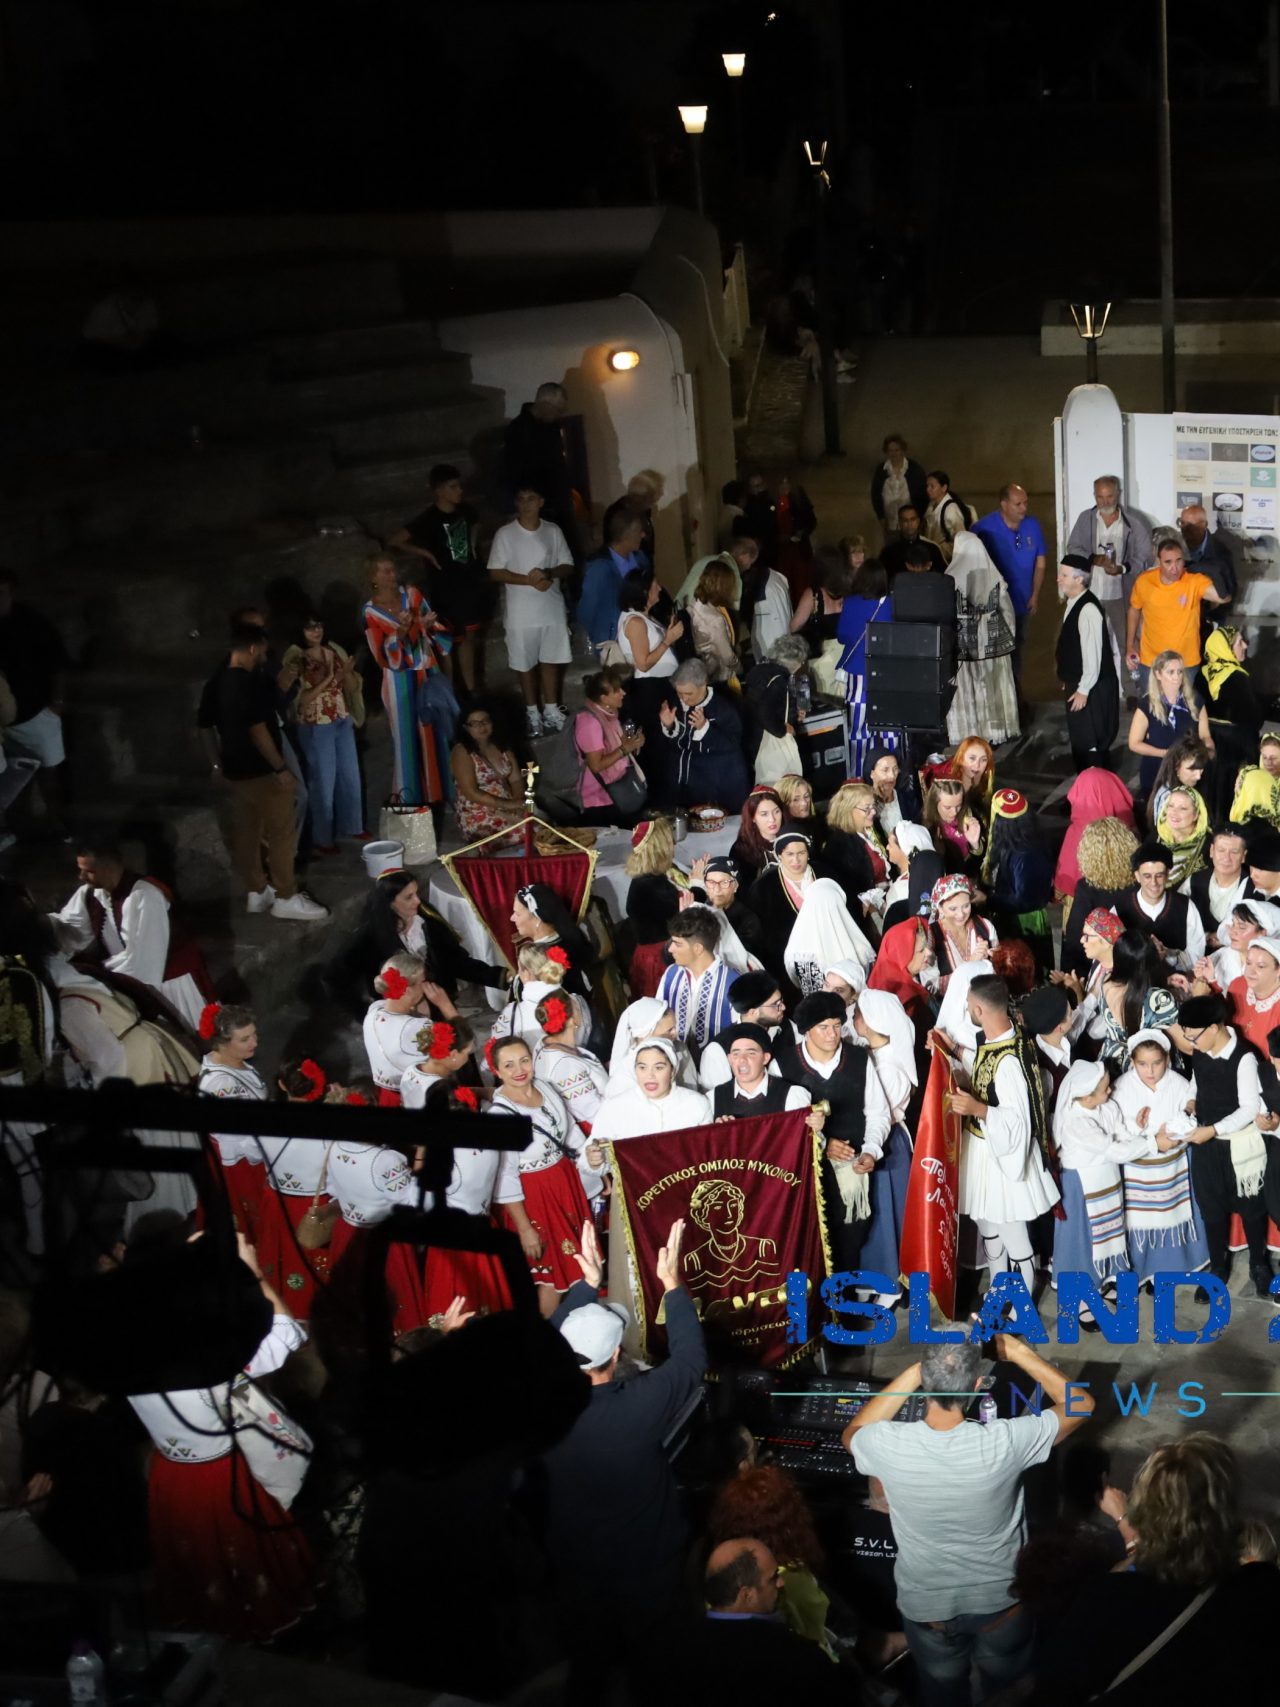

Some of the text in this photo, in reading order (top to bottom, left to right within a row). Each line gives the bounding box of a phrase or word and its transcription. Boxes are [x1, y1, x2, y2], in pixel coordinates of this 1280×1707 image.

[1176, 425, 1185, 433] ΜΕ
[699, 1158, 746, 1173] ΟΜΙΛΟΣ
[748, 1160, 802, 1187] ΜΥΚΟΝΟΥ
